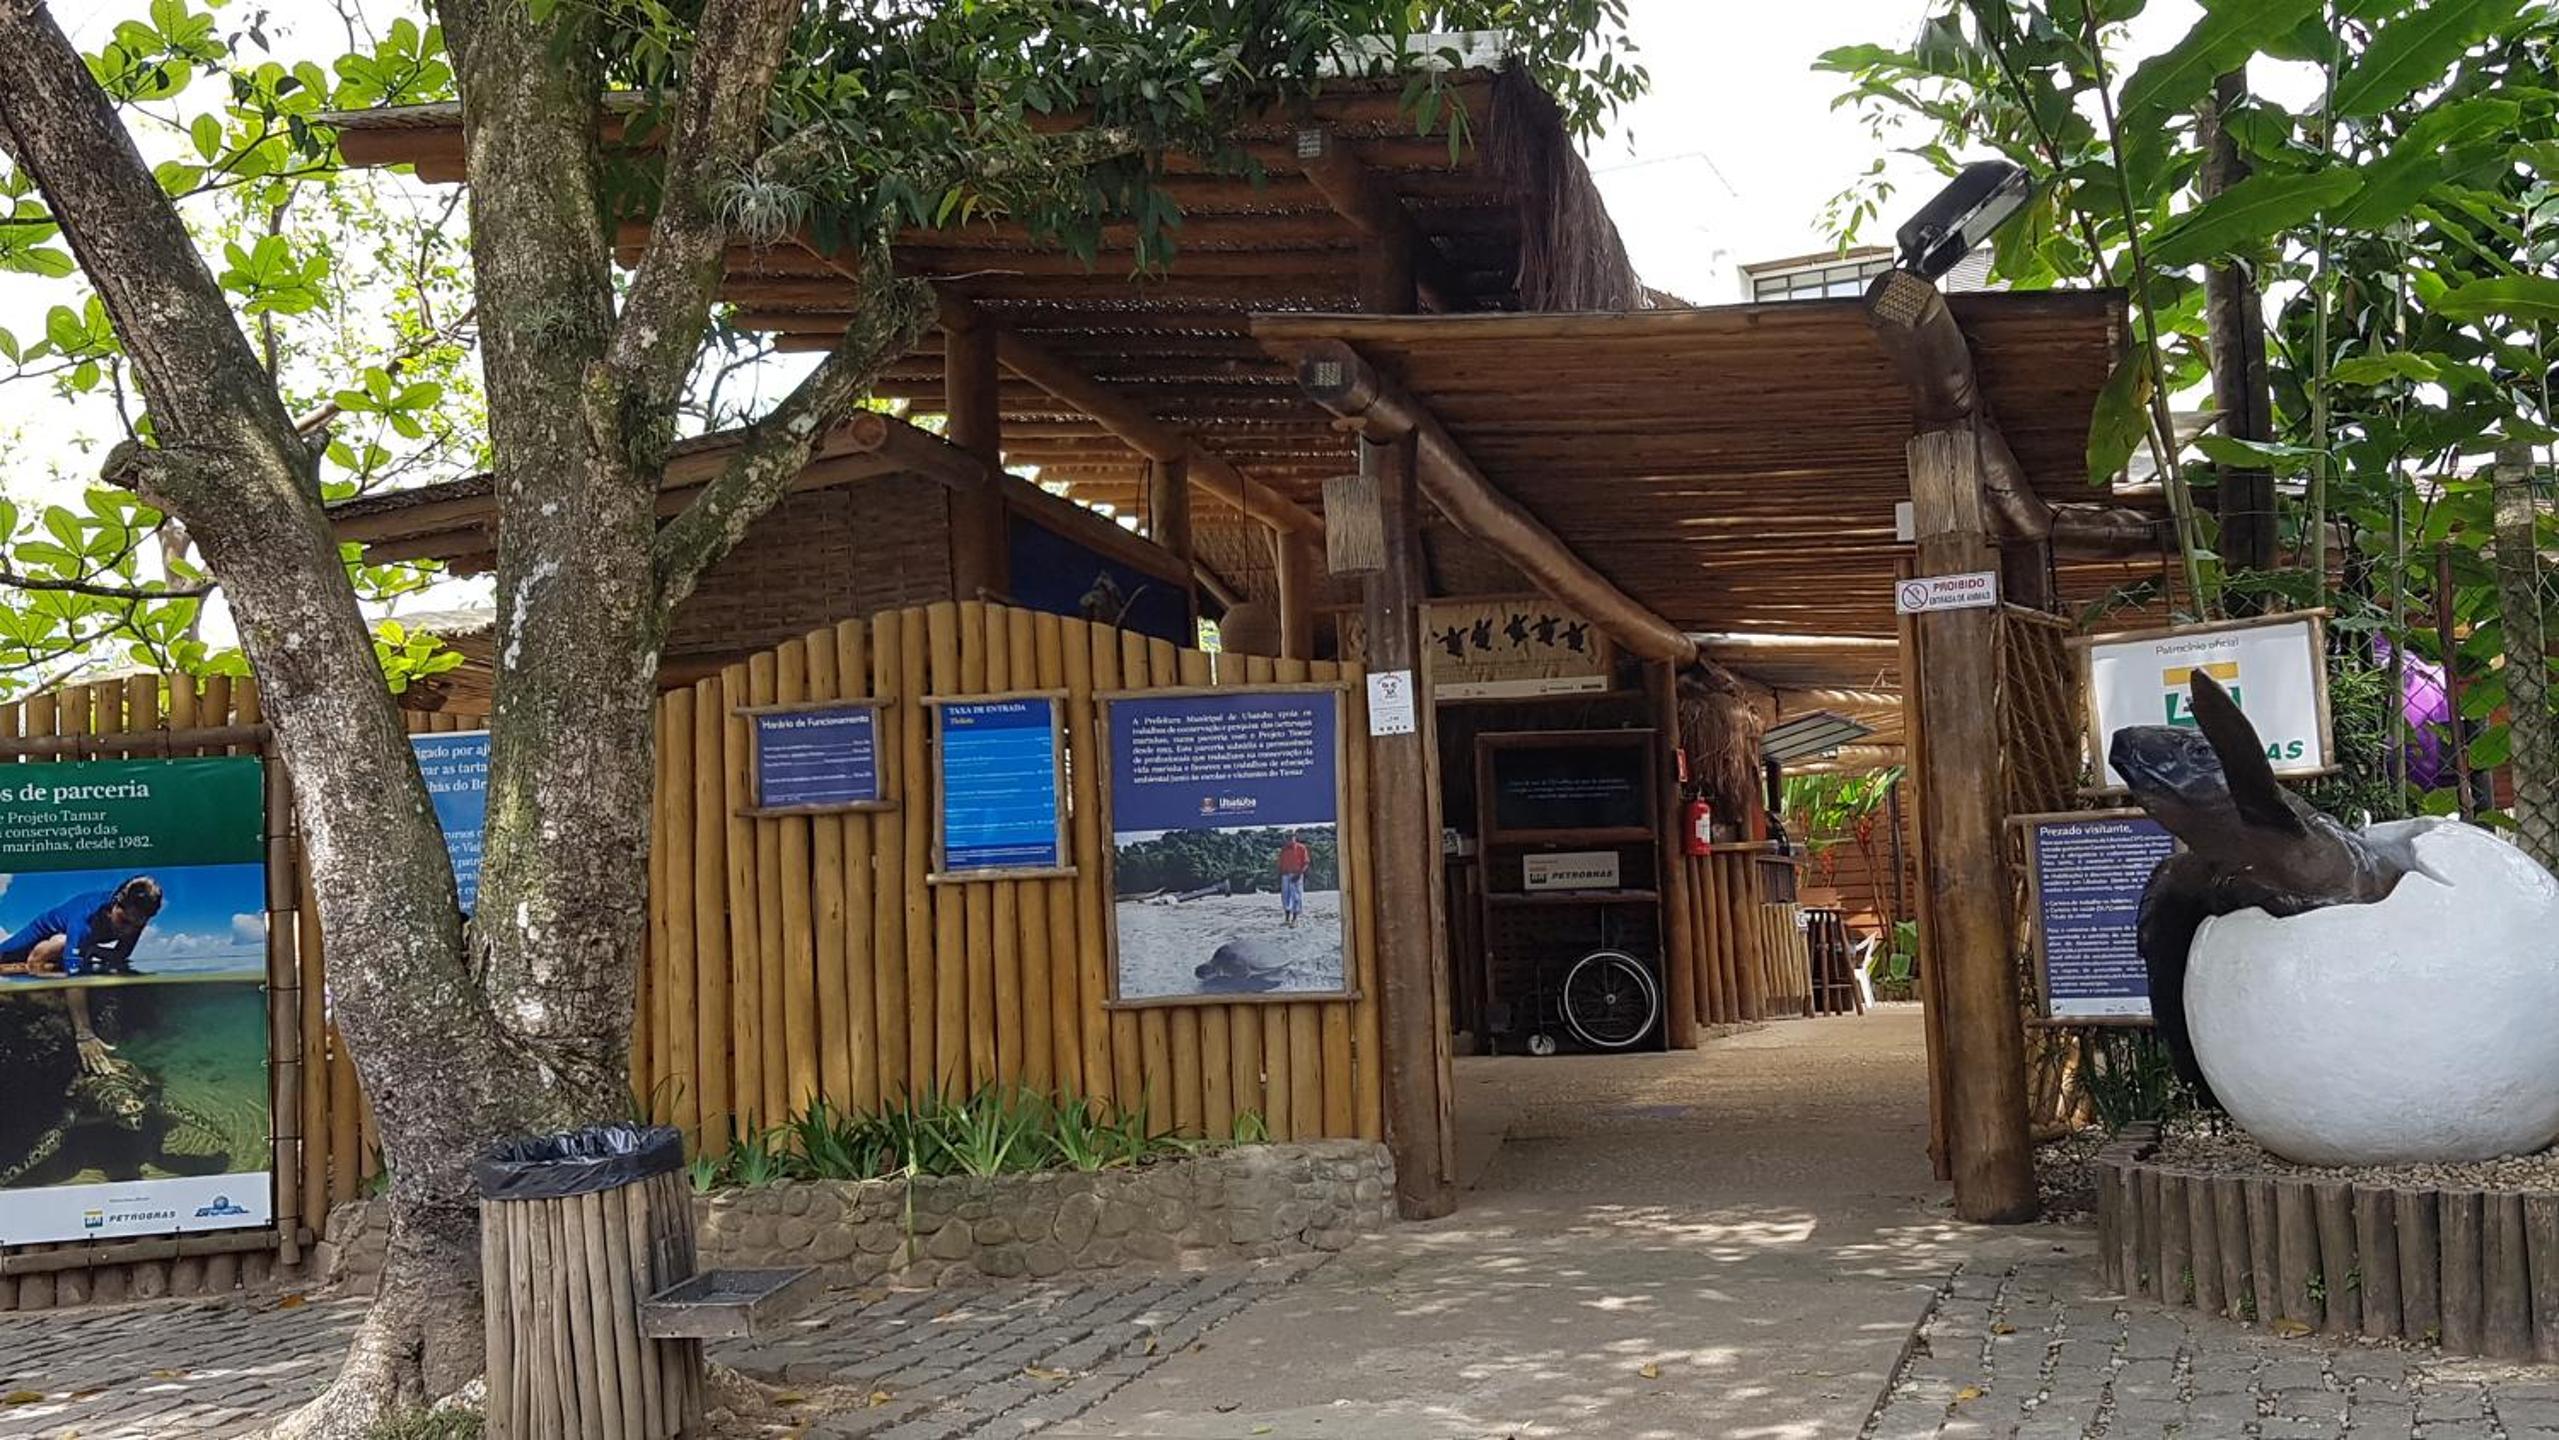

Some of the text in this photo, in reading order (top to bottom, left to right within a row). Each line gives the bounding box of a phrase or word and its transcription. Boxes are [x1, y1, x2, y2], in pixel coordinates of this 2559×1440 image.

[1933, 578, 1985, 592] PROIBIDO
[2208, 636, 2240, 649] oficial
[948, 703, 1027, 715] TAXA DE ENTRADA
[761, 714, 870, 730] Horário de Funcionamento
[451, 745, 475, 759] por
[2266, 740, 2304, 760] AS
[441, 765, 456, 776] as
[19, 783, 48, 801] de
[53, 779, 150, 804] parceria
[452, 779, 469, 792] do
[7, 810, 58, 826] Projeto
[58, 809, 107, 823] Tamar
[5, 824, 92, 839] conservação
[93, 823, 119, 836] das
[2040, 826, 2082, 836] Prezado
[2, 839, 73, 853] marinhas,
[75, 836, 116, 850] desde
[1552, 869, 1613, 881] PETROBRAS
[108, 1210, 177, 1223] PETROBRAS
